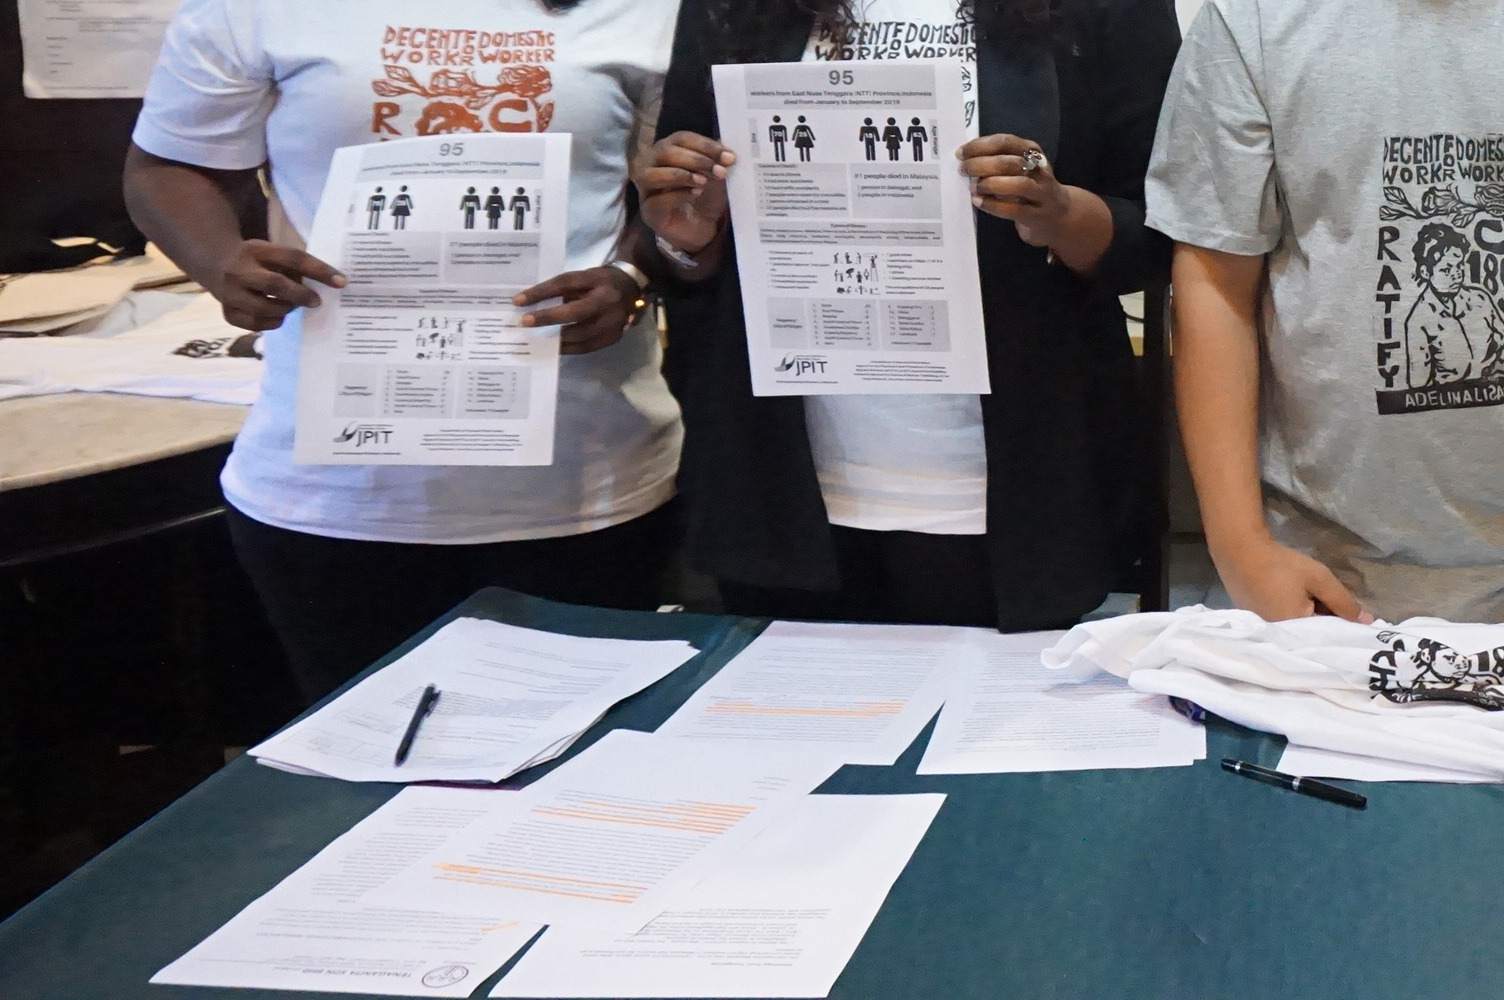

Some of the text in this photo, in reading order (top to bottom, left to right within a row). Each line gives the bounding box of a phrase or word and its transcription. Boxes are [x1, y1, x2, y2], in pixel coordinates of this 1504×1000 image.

[383, 25, 555, 49] DECENT DOMESTIC
[381, 48, 554, 65] WORK WORKER
[828, 70, 855, 85] 95
[438, 142, 465, 156] 95
[1376, 226, 1402, 387] RATIFY
[795, 360, 828, 376] JPIT
[355, 431, 394, 447] JPIT
